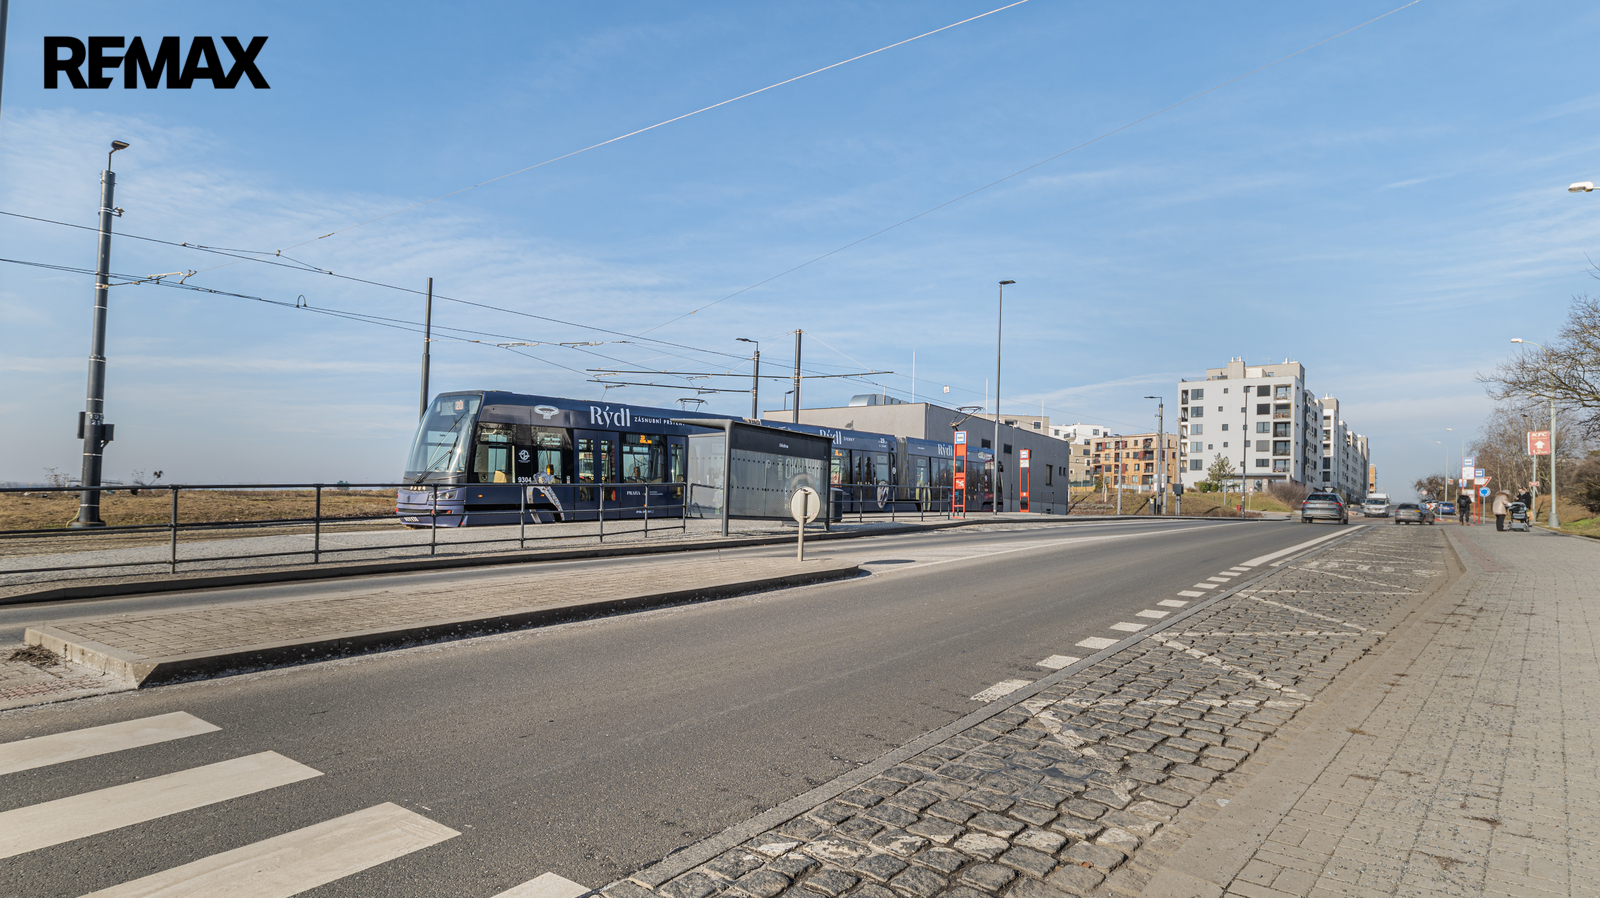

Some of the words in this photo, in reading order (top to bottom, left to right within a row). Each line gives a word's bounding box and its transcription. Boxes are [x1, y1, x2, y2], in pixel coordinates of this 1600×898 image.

[455, 400, 463, 410] 20
[590, 406, 631, 428] Rýdl
[634, 416, 662, 424] ZÁSNUBNÍ
[937, 443, 953, 457] Rýdl
